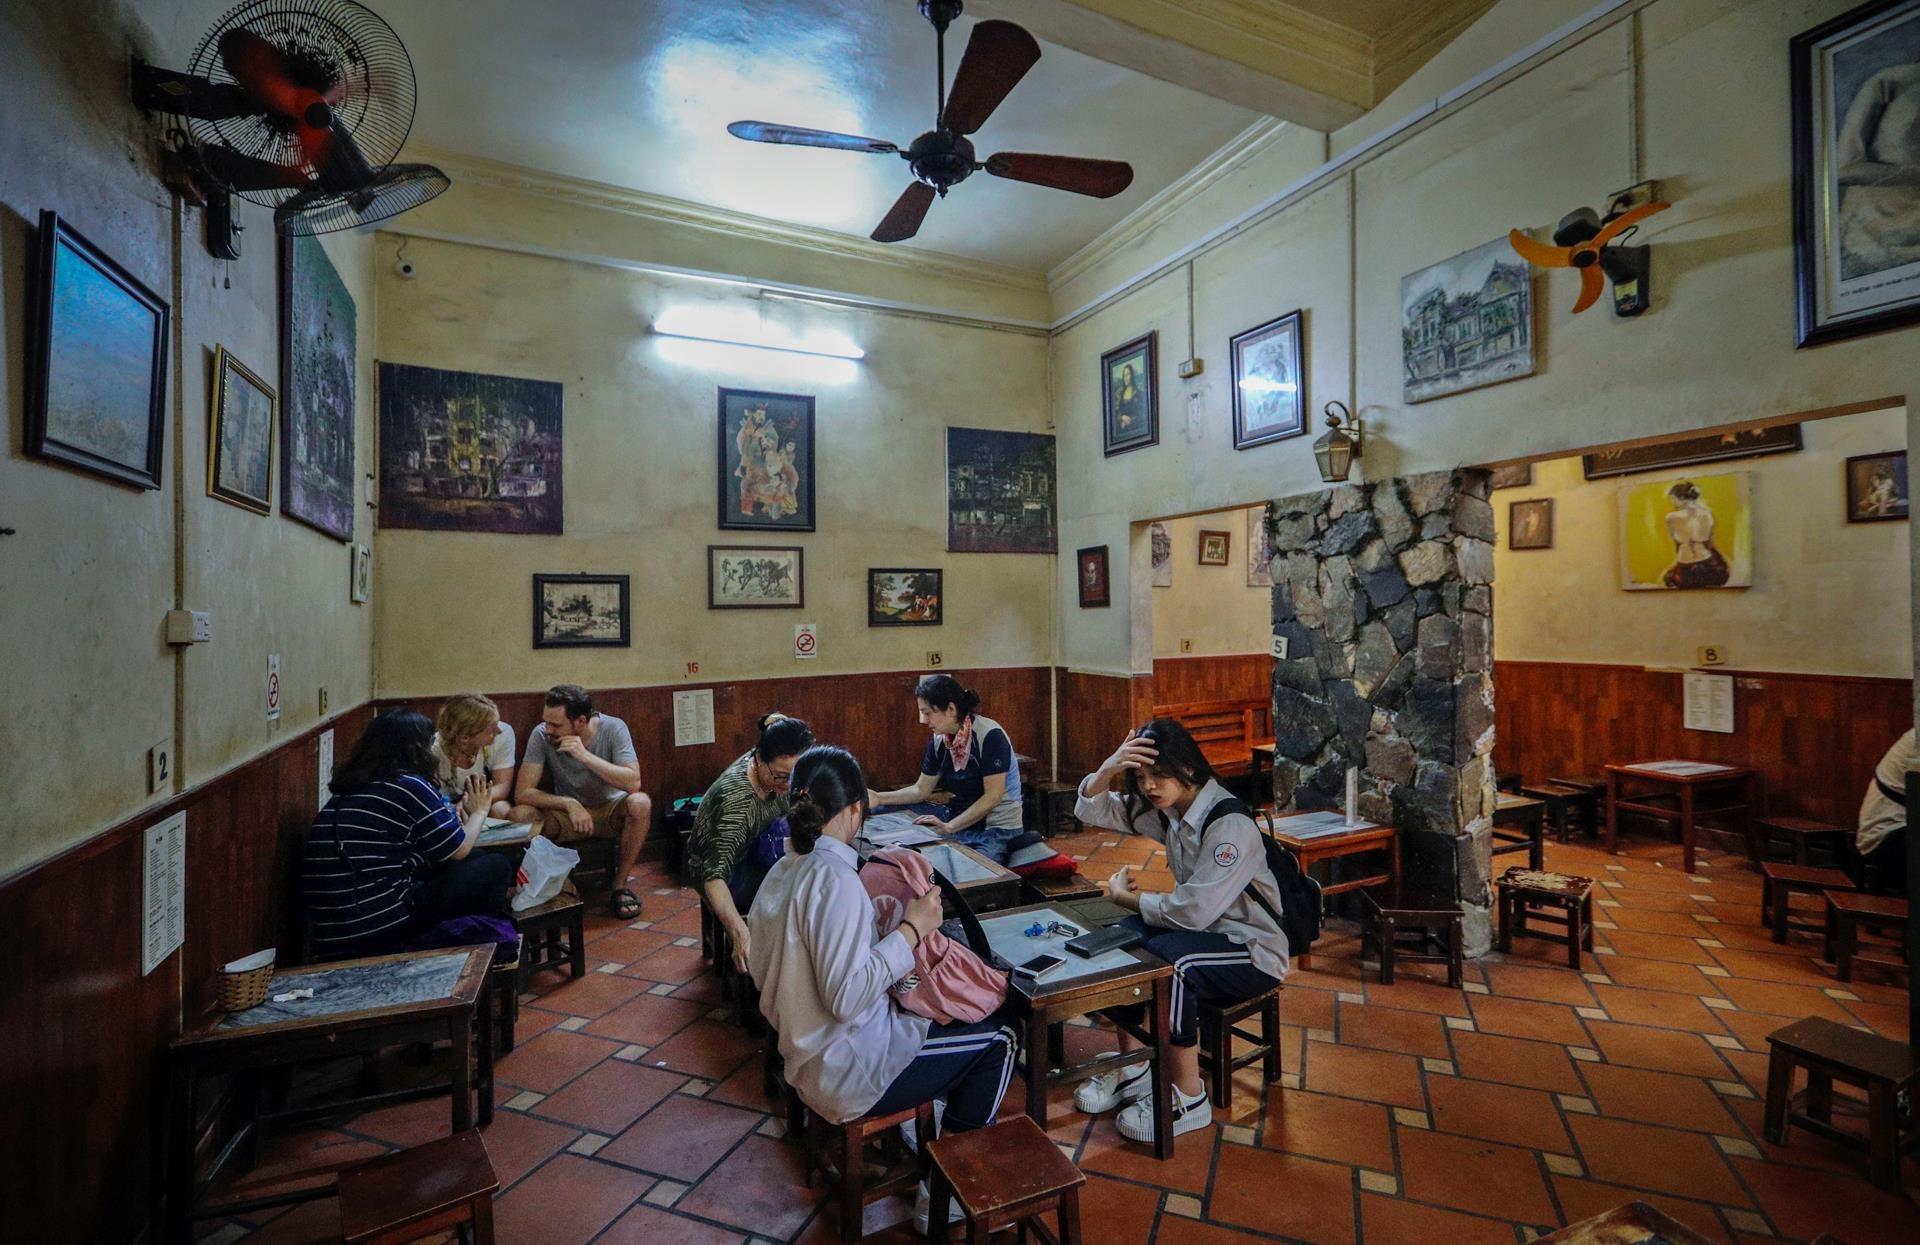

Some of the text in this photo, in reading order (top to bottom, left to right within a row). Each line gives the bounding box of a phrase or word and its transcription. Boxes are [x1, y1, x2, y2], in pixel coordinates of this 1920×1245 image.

[1274, 640, 1282, 654] 5
[1705, 648, 1718, 661] 8
[686, 662, 699, 674] 16
[323, 691, 328, 709] 3
[159, 751, 168, 781] 2
